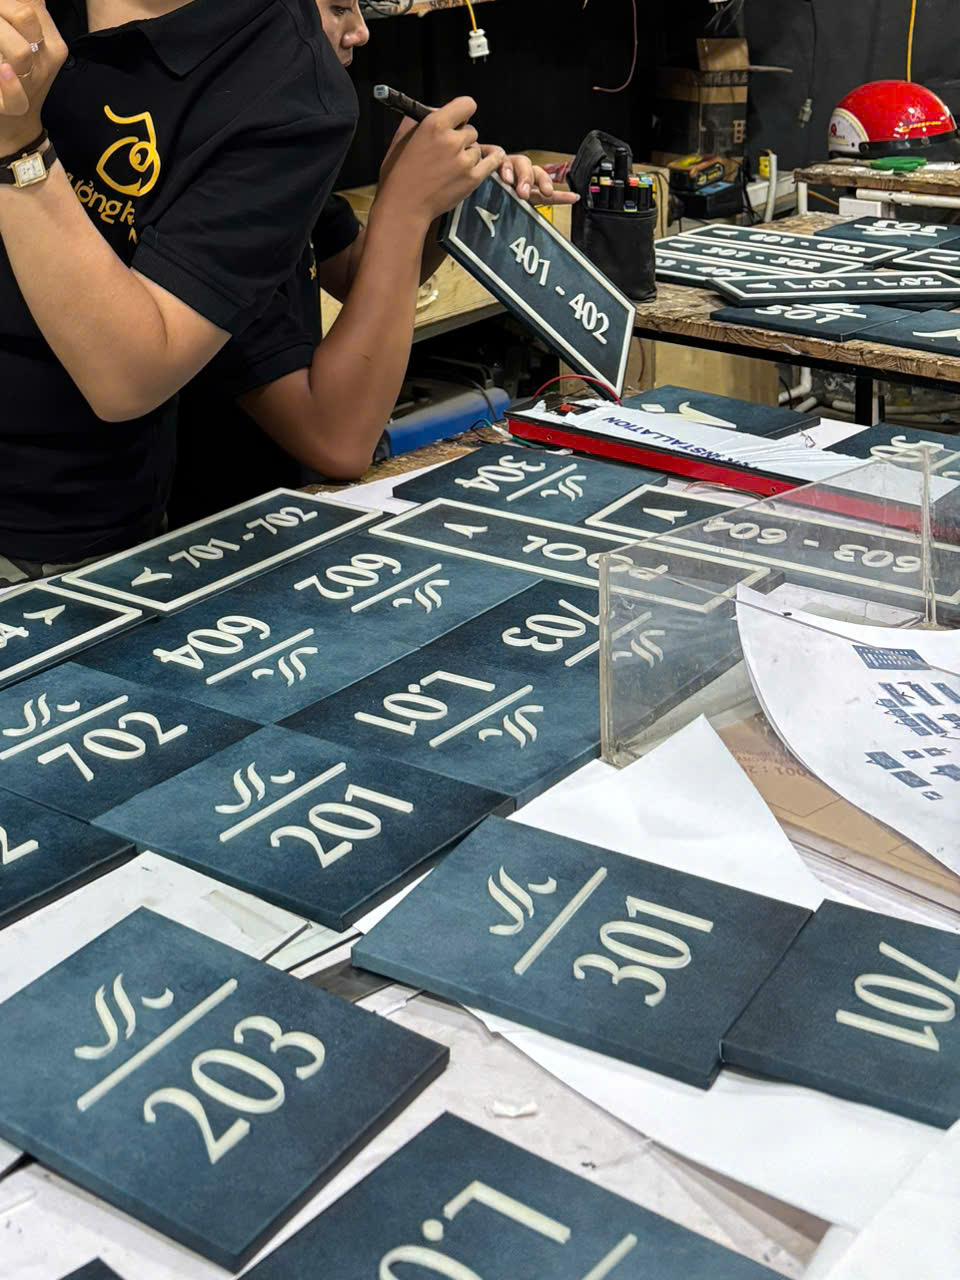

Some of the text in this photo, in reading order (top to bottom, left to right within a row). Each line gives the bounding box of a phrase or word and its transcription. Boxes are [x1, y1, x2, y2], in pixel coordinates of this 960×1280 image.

[509, 236, 551, 286] 401
[568, 293, 610, 345] 402
[603, 417, 724, 461] INSTALLATION
[454, 454, 546, 493] 304
[169, 537, 240, 569] 701
[245, 505, 318, 537] 702
[833, 542, 922, 573] 603
[294, 553, 402, 600] 602
[152, 615, 271, 670] 604
[354, 669, 496, 736] L.01
[38, 711, 188, 782] 702
[270, 783, 414, 869] 201
[572, 895, 715, 1007] 301
[144, 1014, 327, 1165] 203
